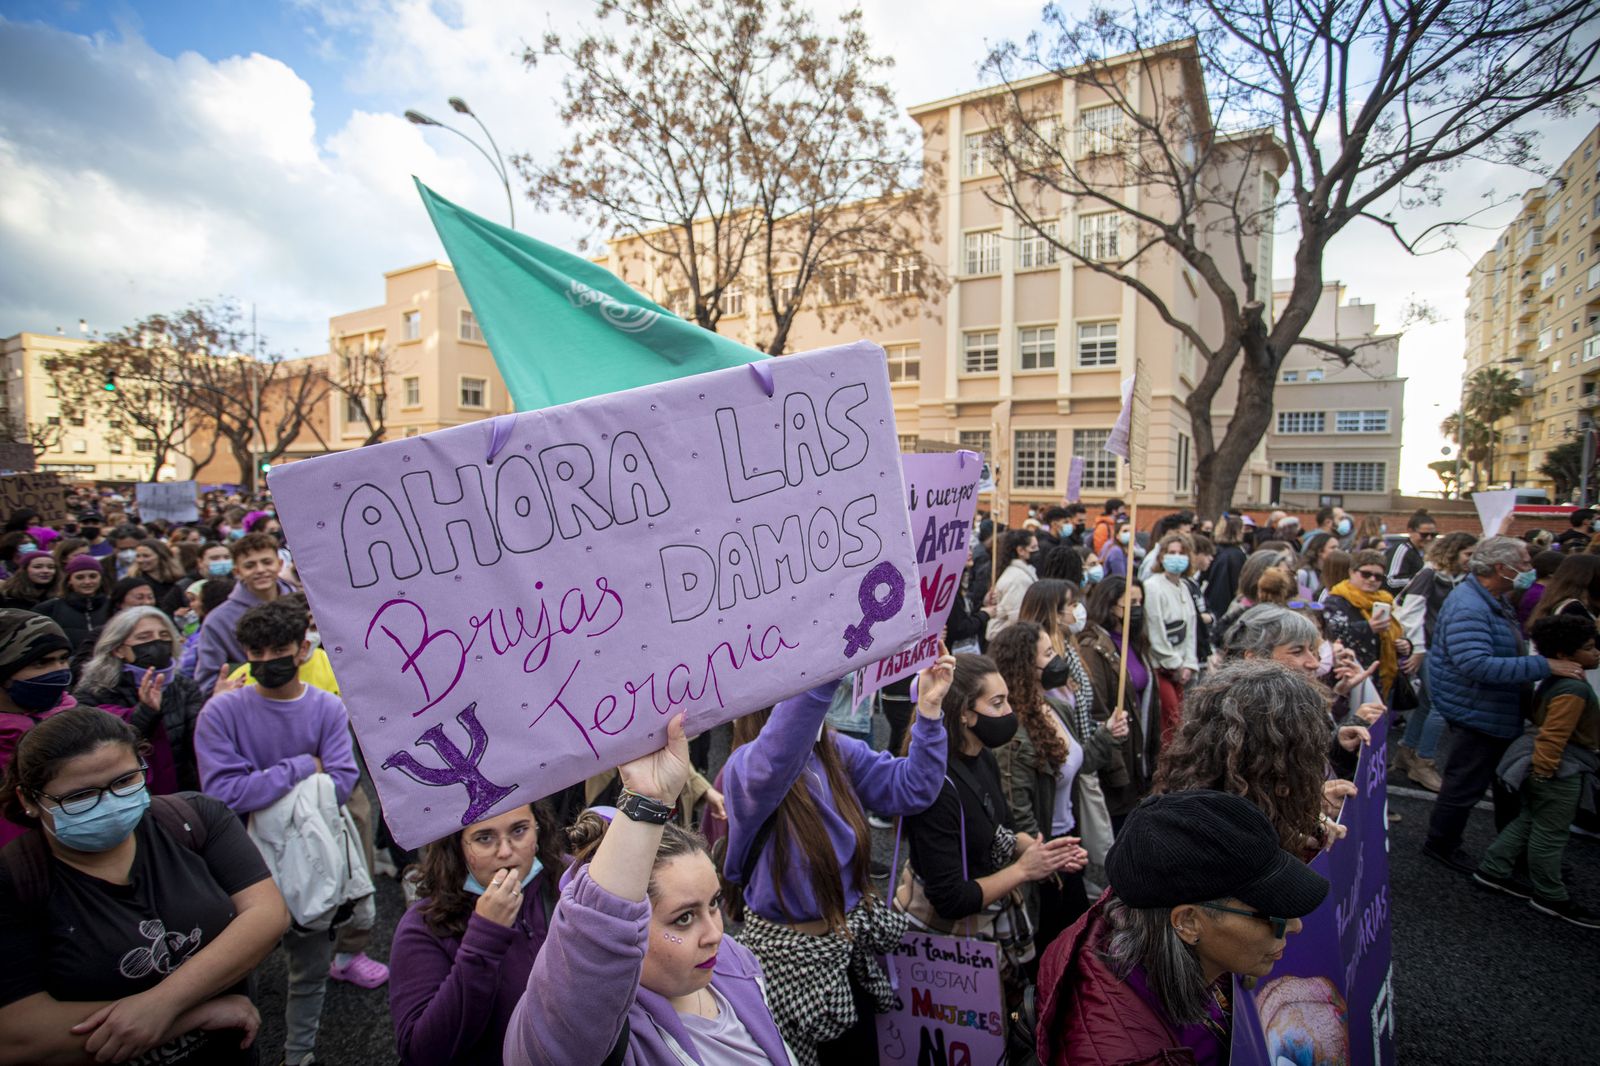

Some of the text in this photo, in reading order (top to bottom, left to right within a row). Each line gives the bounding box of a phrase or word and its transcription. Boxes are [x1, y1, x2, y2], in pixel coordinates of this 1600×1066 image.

[341, 382, 869, 588] AHORA LAS
[927, 482, 976, 517] cuerpo
[917, 516, 969, 564] ARTE
[365, 494, 882, 717] Brujas DAMOS
[529, 624, 799, 759] Terapia
[922, 937, 993, 968] también
[911, 962, 979, 993] GUSTAN
[911, 987, 1002, 1036] MUJERES
